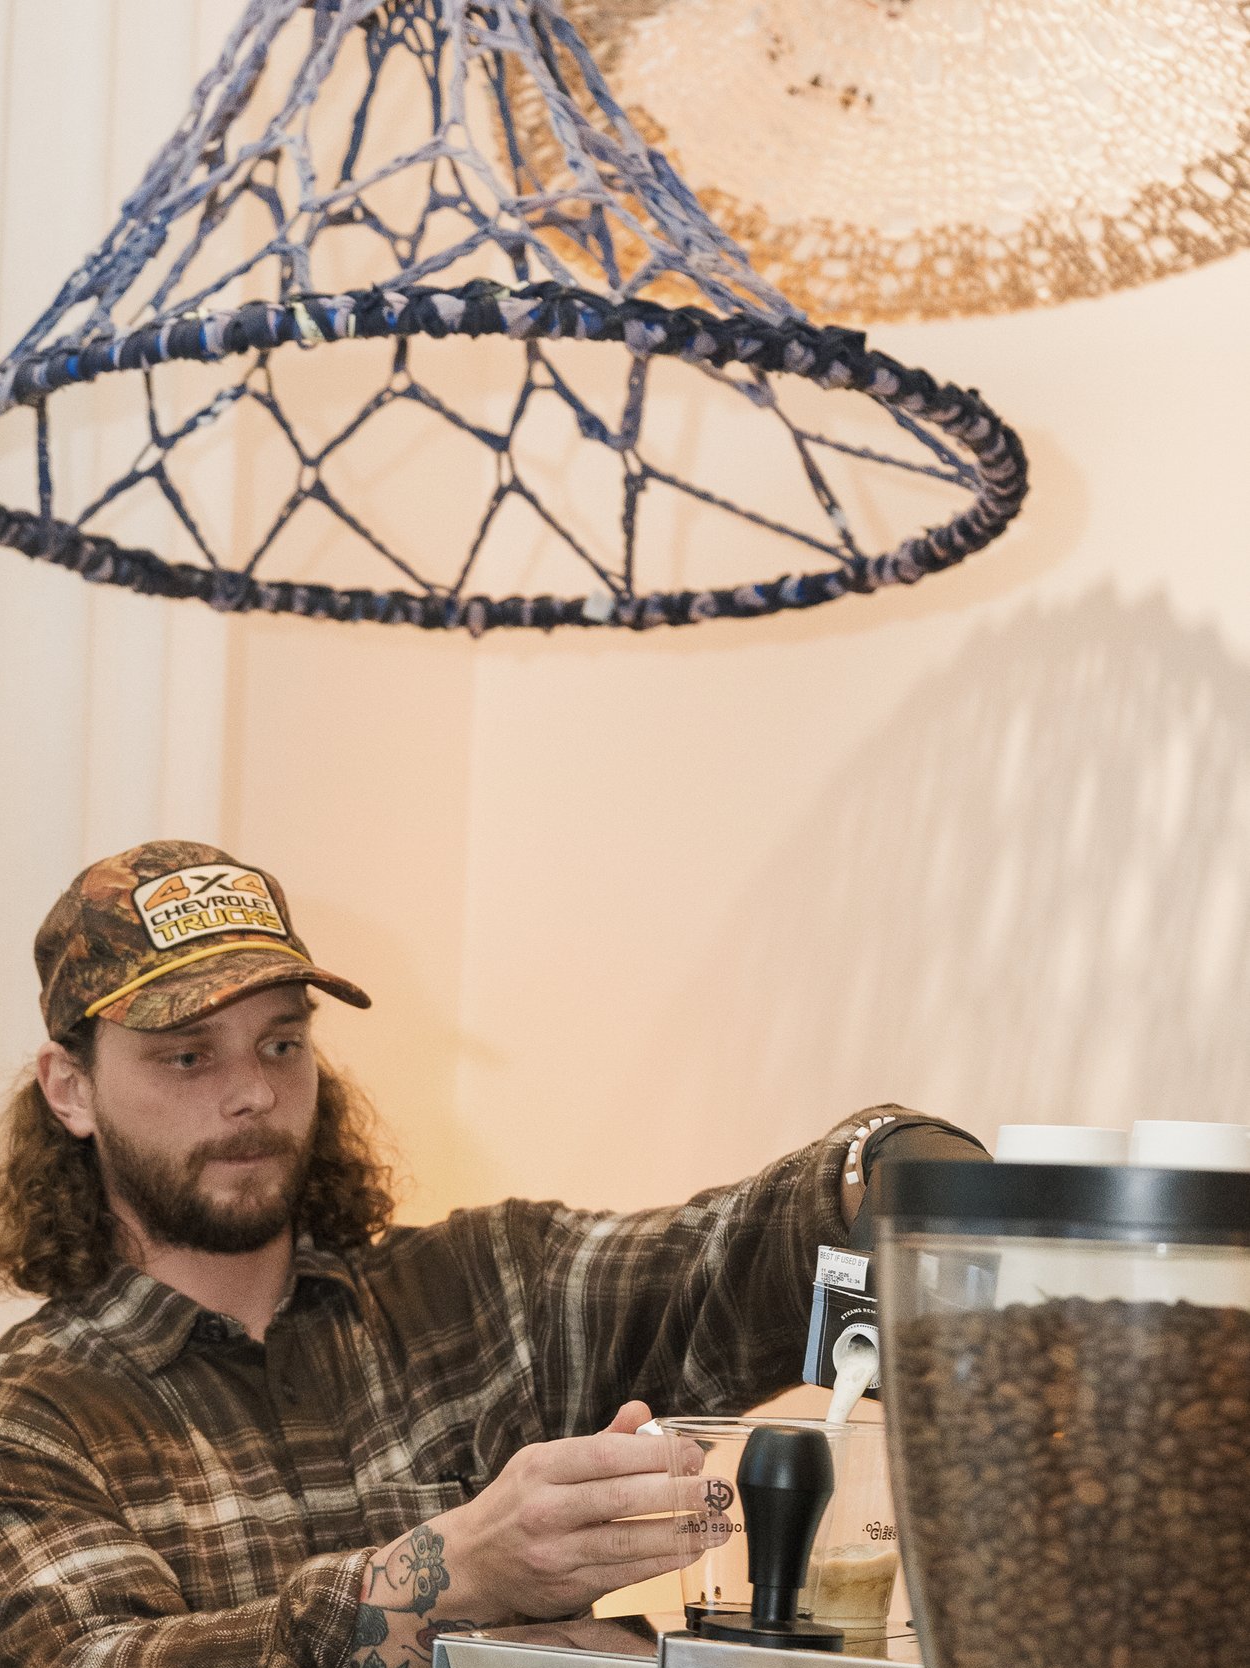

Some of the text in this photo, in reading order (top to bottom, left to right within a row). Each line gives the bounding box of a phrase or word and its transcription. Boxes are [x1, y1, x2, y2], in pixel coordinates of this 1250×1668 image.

[150, 895, 271, 926] CHEVROLET
[153, 906, 281, 942] TRUCKS
[820, 1251, 833, 1260] BEST
[841, 1257, 857, 1266] USED
[840, 1308, 863, 1321] STEAMS
[870, 1527, 897, 1541] Glass
